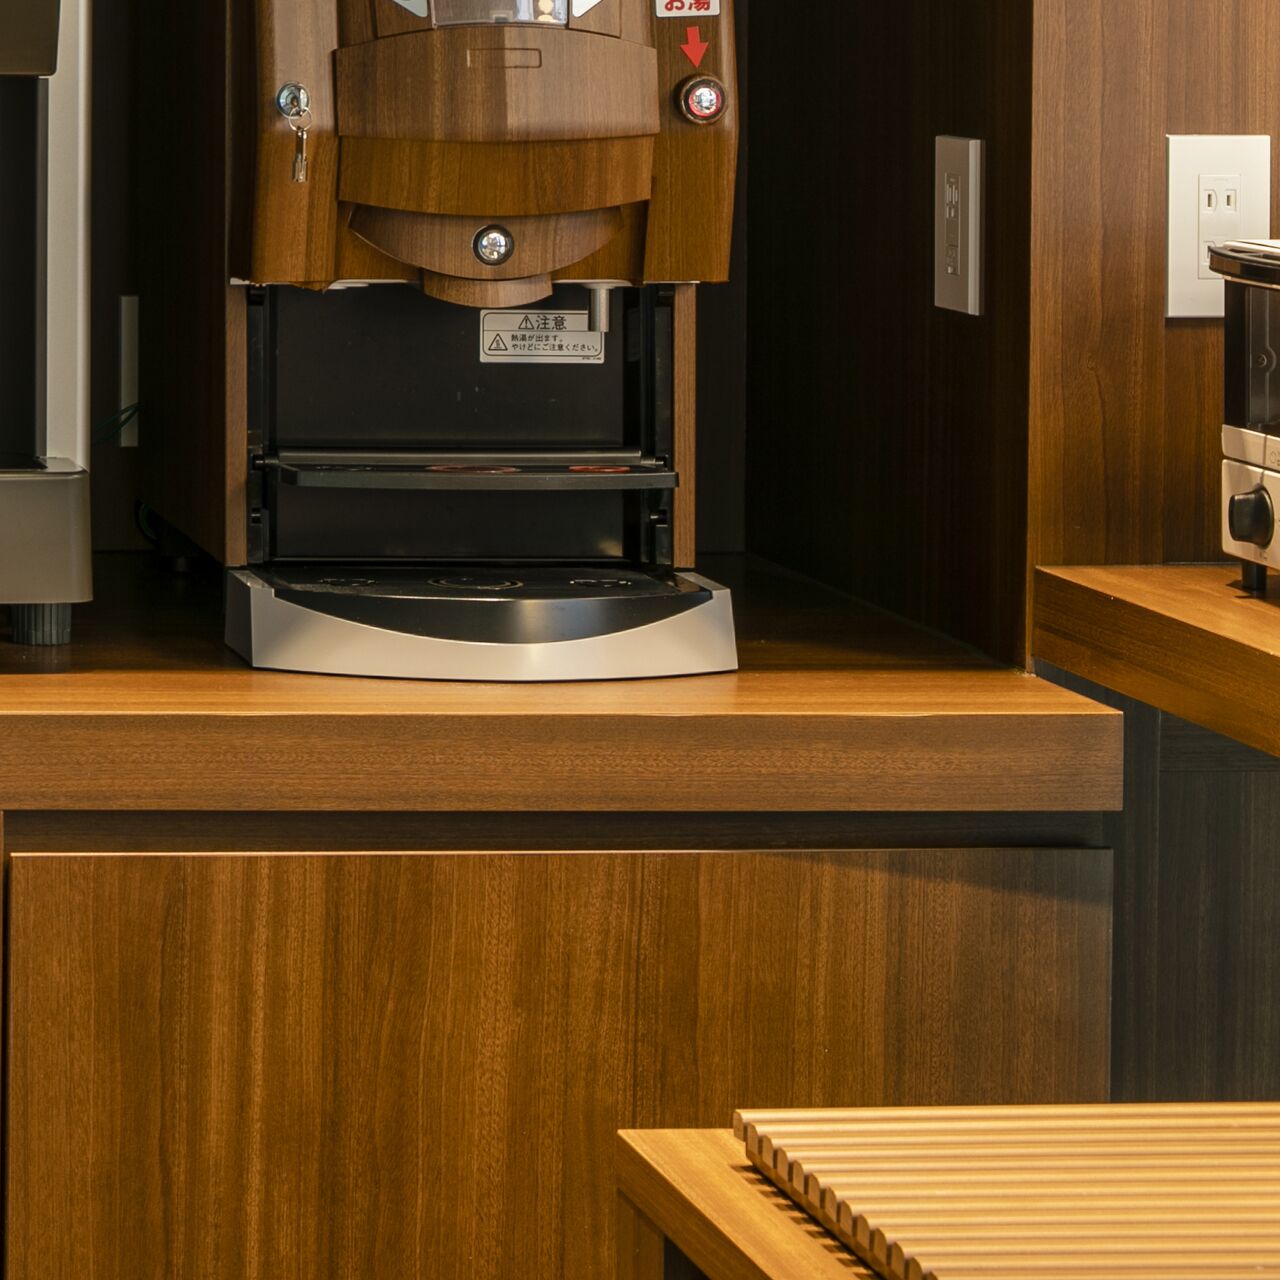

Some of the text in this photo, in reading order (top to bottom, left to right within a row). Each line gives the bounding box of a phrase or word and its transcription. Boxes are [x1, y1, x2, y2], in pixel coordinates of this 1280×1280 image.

[536, 315, 567, 330] 注意
[511, 334, 562, 342] 熱湯が出ます。
[512, 343, 598, 351] やけどにご注意ください。
